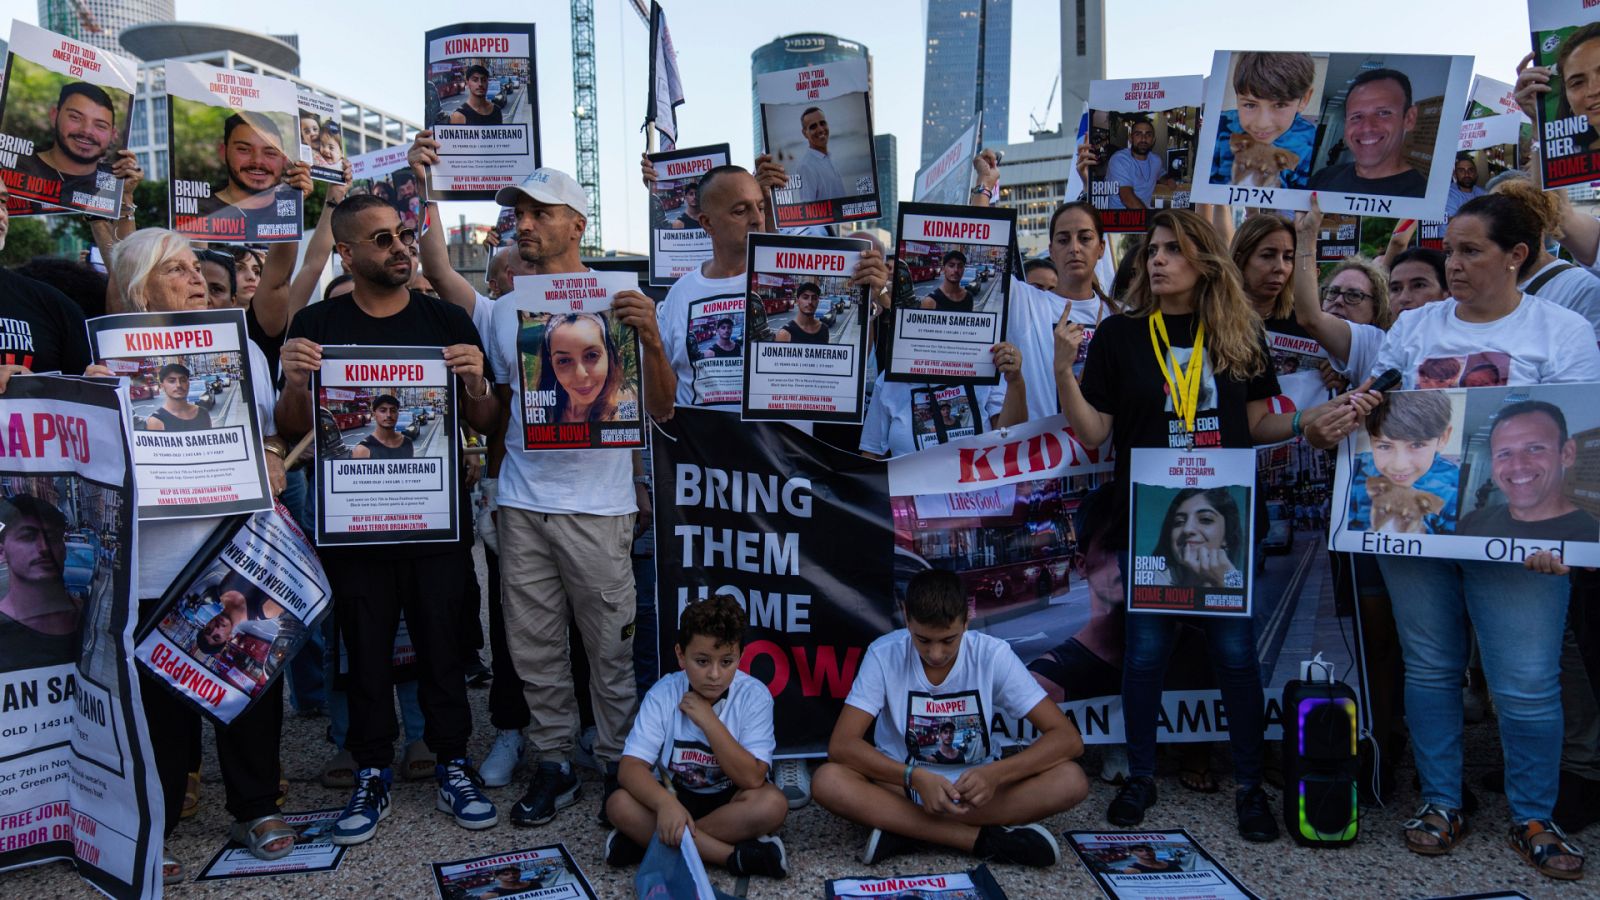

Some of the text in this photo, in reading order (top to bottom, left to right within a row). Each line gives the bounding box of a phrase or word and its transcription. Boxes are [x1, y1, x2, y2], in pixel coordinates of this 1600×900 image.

[445, 38, 509, 56] KIDNAPPED
[52, 49, 102, 73] OMER WENKERT
[69, 65, 83, 77] (22)
[209, 82, 260, 98] OMER WENKERT
[1125, 90, 1165, 100] SEGEV KALFON
[229, 94, 243, 107] (22)
[438, 129, 522, 140] JONATHAN SAMERANO
[1545, 115, 1589, 140] BRING
[1546, 136, 1576, 159] HER
[0, 150, 18, 169] IM
[667, 159, 712, 176] KIDNAPPED
[1548, 153, 1589, 178] HOME
[25, 175, 62, 196] NOW!
[175, 180, 211, 198] BRING
[1092, 181, 1119, 195] BRING
[175, 197, 198, 214] HIM
[775, 190, 793, 205] HIM
[1092, 195, 1109, 209] HIM
[1229, 187, 1393, 213] אוהד איתן
[777, 206, 804, 221] HOME
[805, 200, 833, 217] NOW!
[175, 216, 246, 234] HOME NOW!
[923, 220, 991, 240] KIDNAPPED
[1421, 225, 1438, 239] HIM
[662, 232, 694, 241] JONATHAN
[776, 252, 846, 271] KIDNAPPED
[545, 288, 607, 301] MORAN STELA YANAI
[570, 299, 583, 310] (40)
[703, 299, 746, 315] KIDNAPPE
[906, 313, 991, 327] JONATHAN SAMERANO
[125, 330, 213, 351] KIDNAPPED
[1274, 335, 1320, 353] KIDNAPPED
[761, 346, 848, 360] JONATHAN SAMERANO
[345, 364, 424, 381] KIDNAPPED
[524, 391, 556, 407] BRING
[526, 408, 546, 424] HER
[1197, 416, 1220, 431] EDEN
[0, 413, 90, 463] APPED
[136, 432, 239, 448] JONATHAN SAMERANO
[527, 423, 590, 442] HOME NOW!
[1195, 431, 1222, 446] NOW!
[337, 462, 436, 475] JONATHAN SAMERANO
[1169, 467, 1215, 476] EDEN ZECHARYA
[675, 463, 813, 518] BRING
[674, 525, 801, 576] THEM
[1362, 532, 1422, 556] Eitan
[1135, 556, 1166, 571] BRING
[1135, 570, 1154, 585] HER
[263, 573, 307, 612] JONATHAN
[1134, 587, 1194, 603] HOME NOW!
[151, 642, 227, 707] KIDNAPPED
[738, 640, 863, 698] OW
[2, 719, 61, 738] OLD 143
[20, 767, 37, 778] 7th
[40, 764, 49, 772] in
[20, 776, 52, 790] Green
[1, 811, 32, 830] FREE
[0, 827, 48, 852] ERROR
[465, 852, 540, 870] KIDNAPPED
[1114, 872, 1212, 881] JONATHAN SAMERANO
[518, 886, 568, 900] SAMERANO
